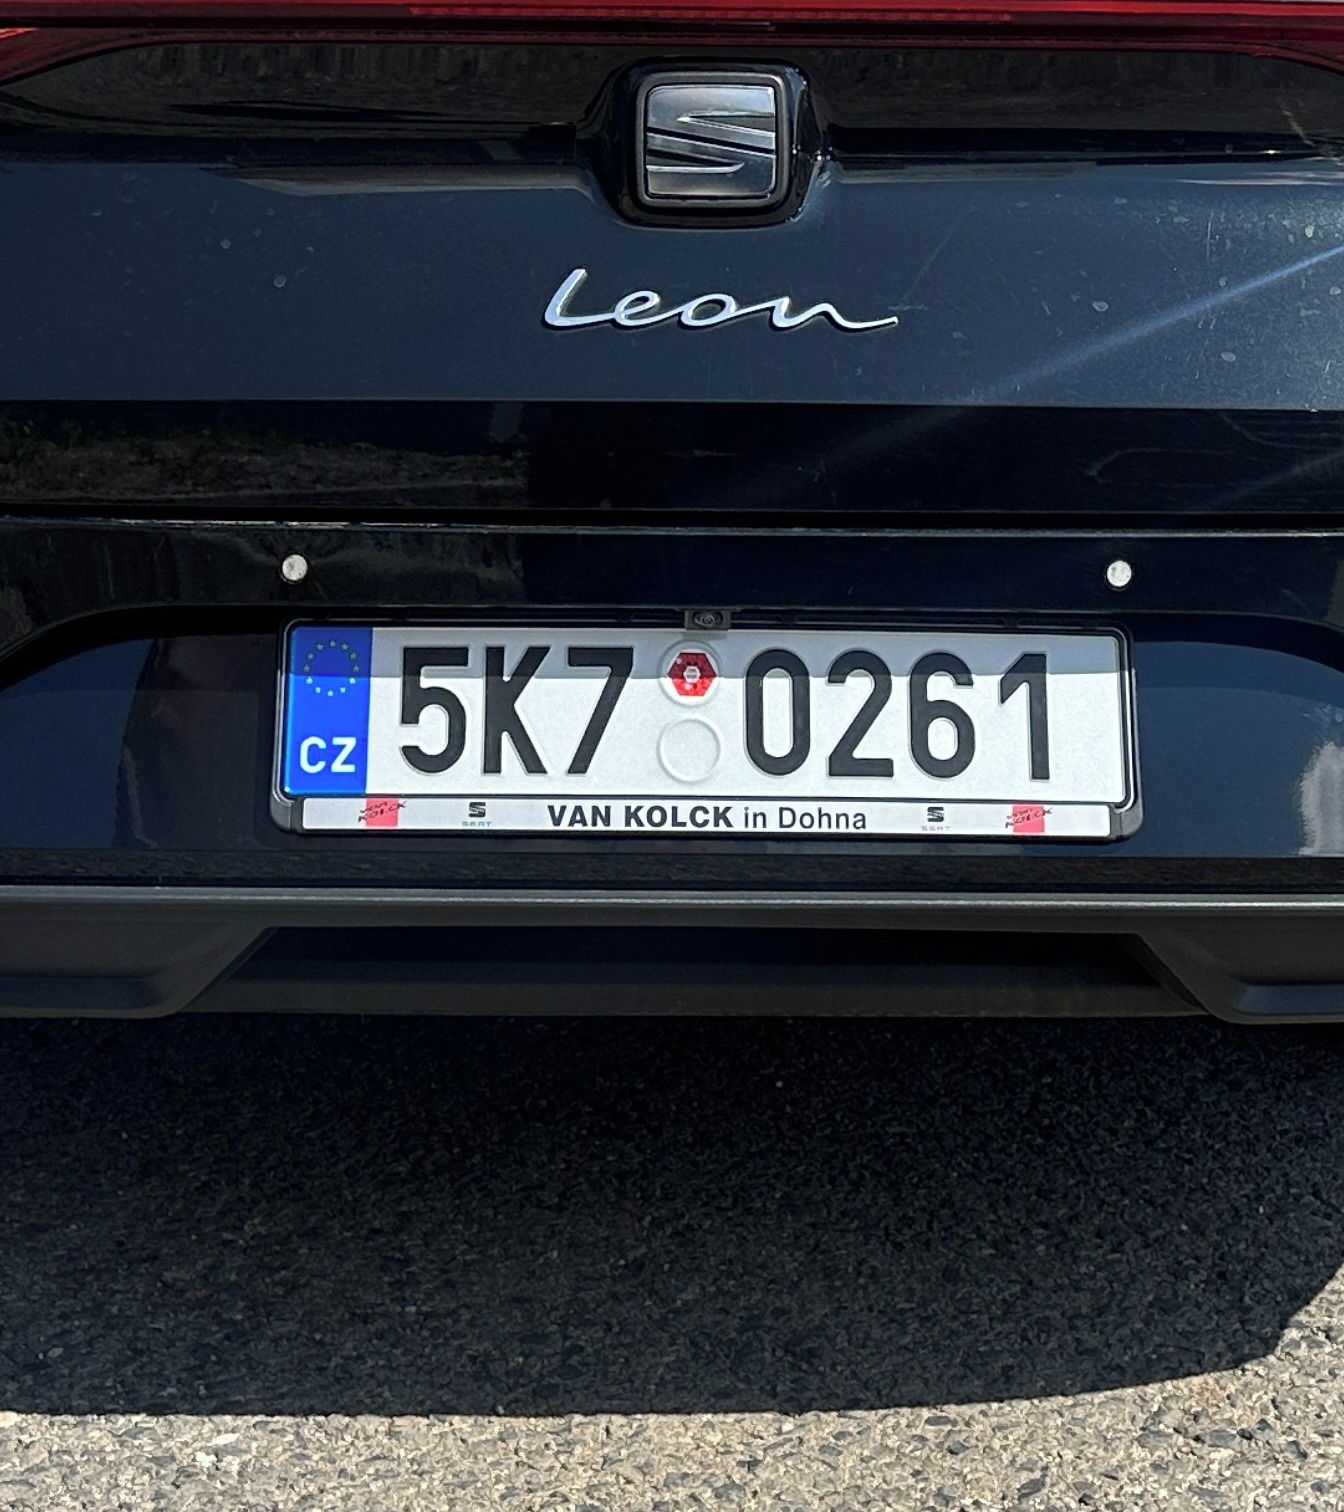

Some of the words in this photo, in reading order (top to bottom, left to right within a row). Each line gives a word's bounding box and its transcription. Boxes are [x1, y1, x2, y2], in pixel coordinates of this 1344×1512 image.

[543, 268, 899, 329] Leon
[400, 645, 634, 775] 5K7
[745, 648, 1050, 780] 0261
[299, 736, 356, 774] CZ
[548, 805, 611, 827] VAN
[624, 805, 734, 828] KOLCK
[744, 806, 767, 828] in
[778, 806, 867, 830] Dohna
